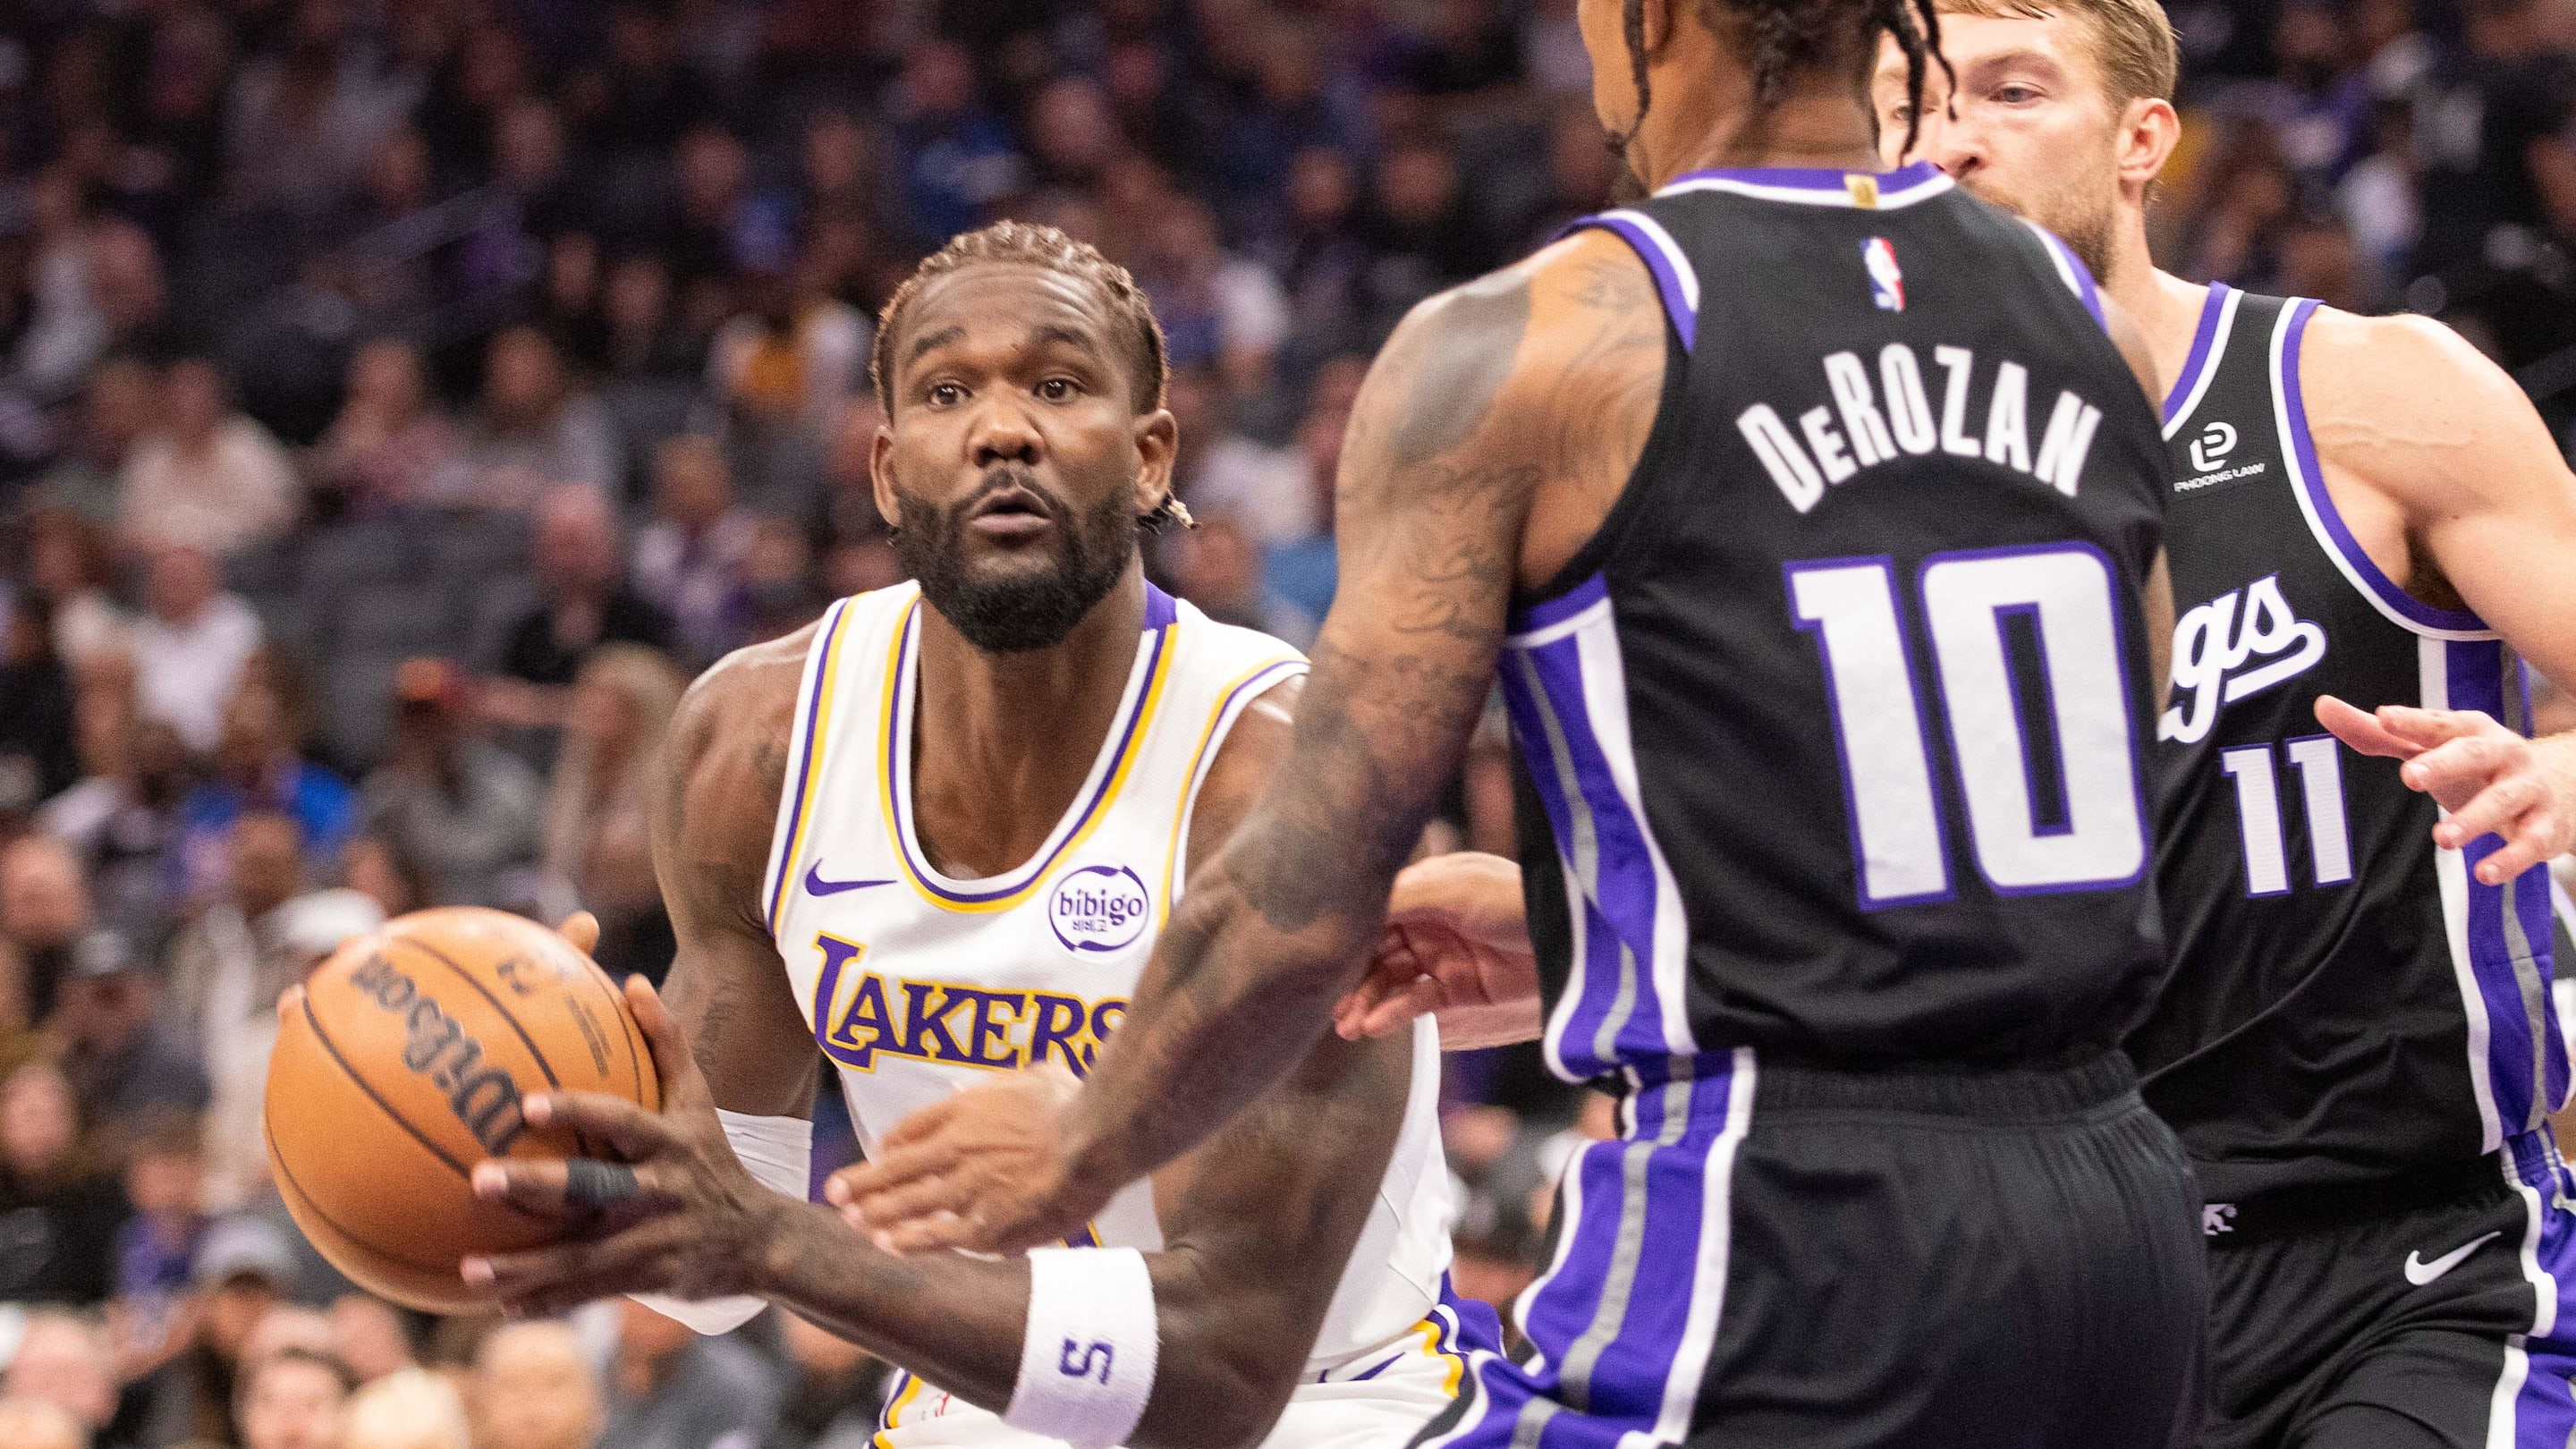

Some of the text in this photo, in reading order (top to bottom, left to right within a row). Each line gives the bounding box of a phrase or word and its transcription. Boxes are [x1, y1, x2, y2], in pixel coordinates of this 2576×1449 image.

[2233, 462, 2266, 478] LAW
[1783, 540, 2146, 911] 10
[2221, 735, 2353, 898] 11
[1059, 888, 1143, 926] bibigo
[350, 950, 529, 1159] Wilson
[1059, 1337, 1113, 1385] 5
